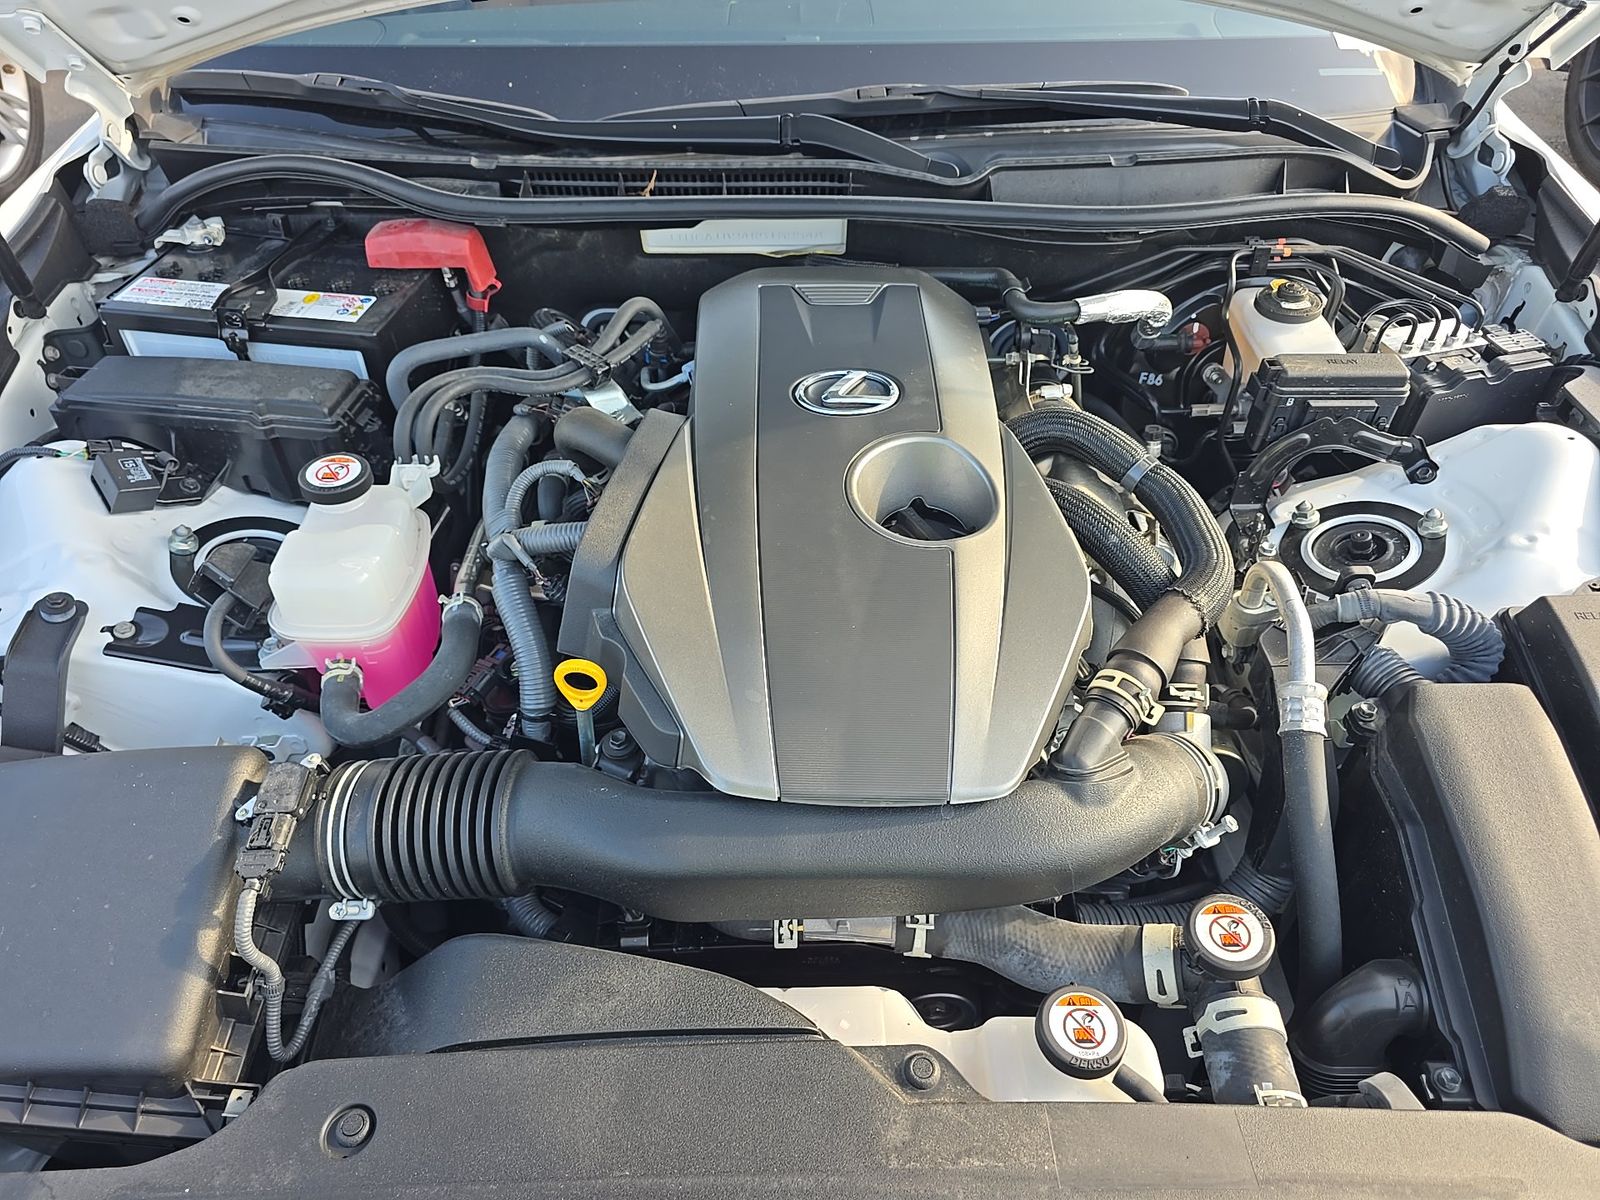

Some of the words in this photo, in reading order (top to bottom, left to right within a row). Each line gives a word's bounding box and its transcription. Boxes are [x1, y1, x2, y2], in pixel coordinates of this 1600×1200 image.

[1573, 611, 1600, 620] REL
[1239, 900, 1272, 930] DENSO
[1069, 1056, 1110, 1069] DENSO
